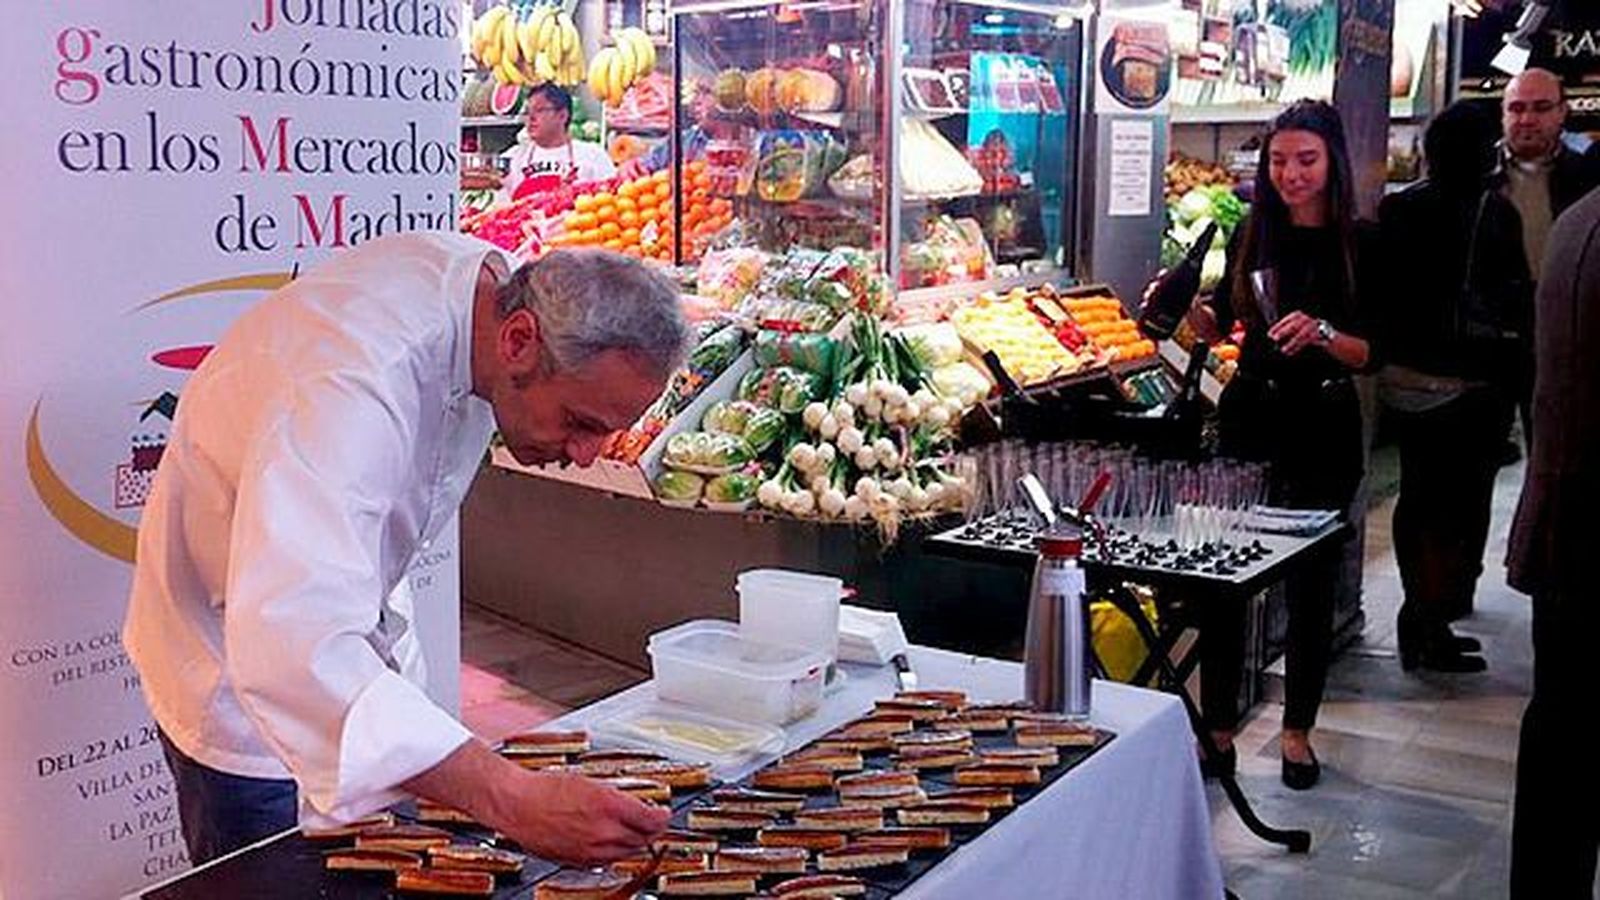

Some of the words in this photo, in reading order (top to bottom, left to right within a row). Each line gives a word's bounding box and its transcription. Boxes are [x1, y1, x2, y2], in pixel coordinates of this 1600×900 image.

[251, 0, 460, 39] Jornadas
[55, 27, 460, 104] gastronómicas
[58, 129, 131, 174] en
[146, 111, 220, 174] los
[239, 115, 458, 177] Mercados
[215, 194, 277, 253] de
[292, 194, 458, 249] Madrid
[12, 646, 58, 667] CON
[90, 652, 131, 675] REST
[37, 753, 79, 777] DEL
[83, 741, 107, 764] 22
[111, 735, 135, 756] AL
[77, 771, 134, 799] VILLA
[109, 821, 133, 841] LA
[139, 806, 174, 831] PAZ
